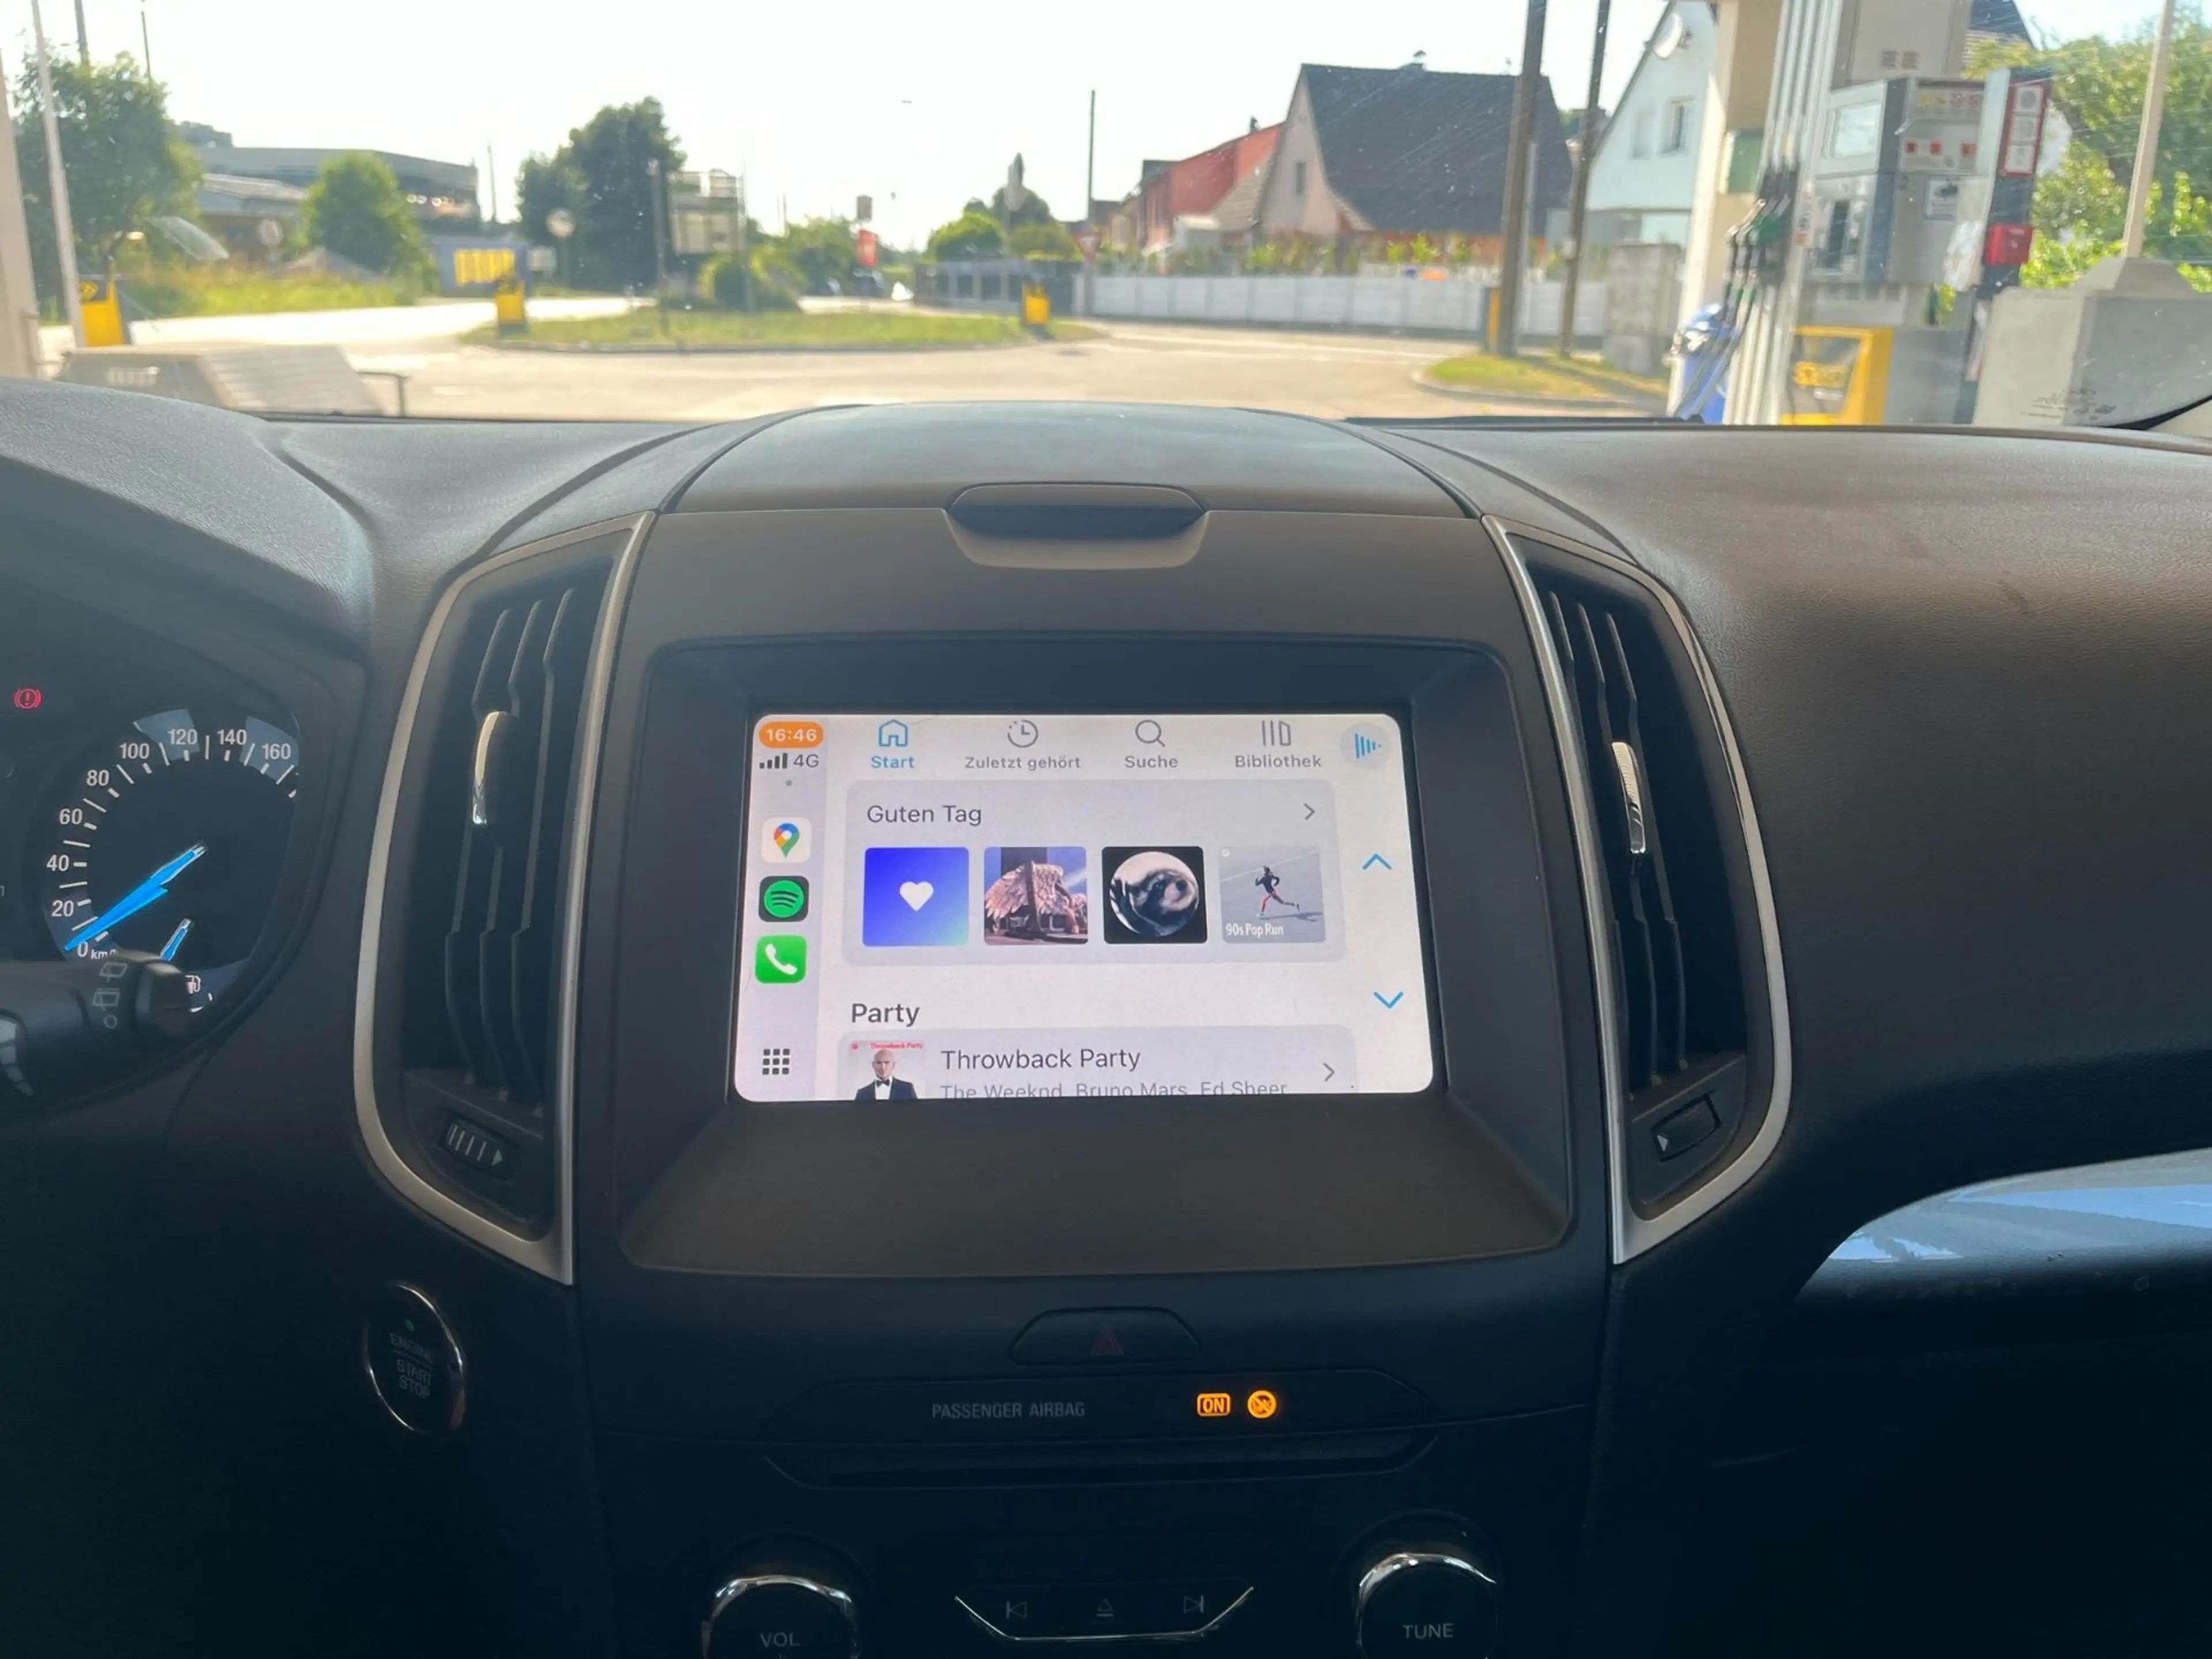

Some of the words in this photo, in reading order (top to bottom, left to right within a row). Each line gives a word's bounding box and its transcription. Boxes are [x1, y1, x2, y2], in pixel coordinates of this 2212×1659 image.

[168, 729, 198, 745] 120
[217, 729, 247, 745] 140
[766, 728, 817, 742] 16:46
[120, 743, 150, 759] 100
[262, 744, 291, 759] 160
[793, 753, 819, 768] 4G
[871, 756, 915, 769] Start
[965, 756, 1022, 769] Zuletzt
[1028, 756, 1081, 772] gehört
[1124, 755, 1178, 768] Suche
[1235, 755, 1322, 768] Bibliothek
[87, 770, 109, 786] 80
[59, 809, 82, 825] 60
[867, 805, 934, 823] Guten
[943, 805, 981, 825] Tag
[47, 855, 69, 871] 40
[52, 900, 74, 916] 20
[1226, 923, 1244, 936] 90s
[1245, 923, 1263, 938] Pop
[1264, 923, 1283, 936] Run
[77, 941, 88, 957] 0
[851, 1003, 920, 1027] Party
[941, 1049, 1071, 1070] Throwback
[1081, 1048, 1141, 1071] Party
[940, 1084, 976, 1099] The
[1077, 1083, 1132, 1097] Bruno
[1201, 1081, 1224, 1095] Ed
[397, 1359, 432, 1385] START
[399, 1374, 430, 1399] STOP
[931, 1402, 1022, 1419] PASSENGER
[1029, 1401, 1085, 1418] AIRBAG
[1203, 1398, 1225, 1413] ON
[1402, 1622, 1454, 1639] TUNE
[760, 1631, 801, 1649] VOL
